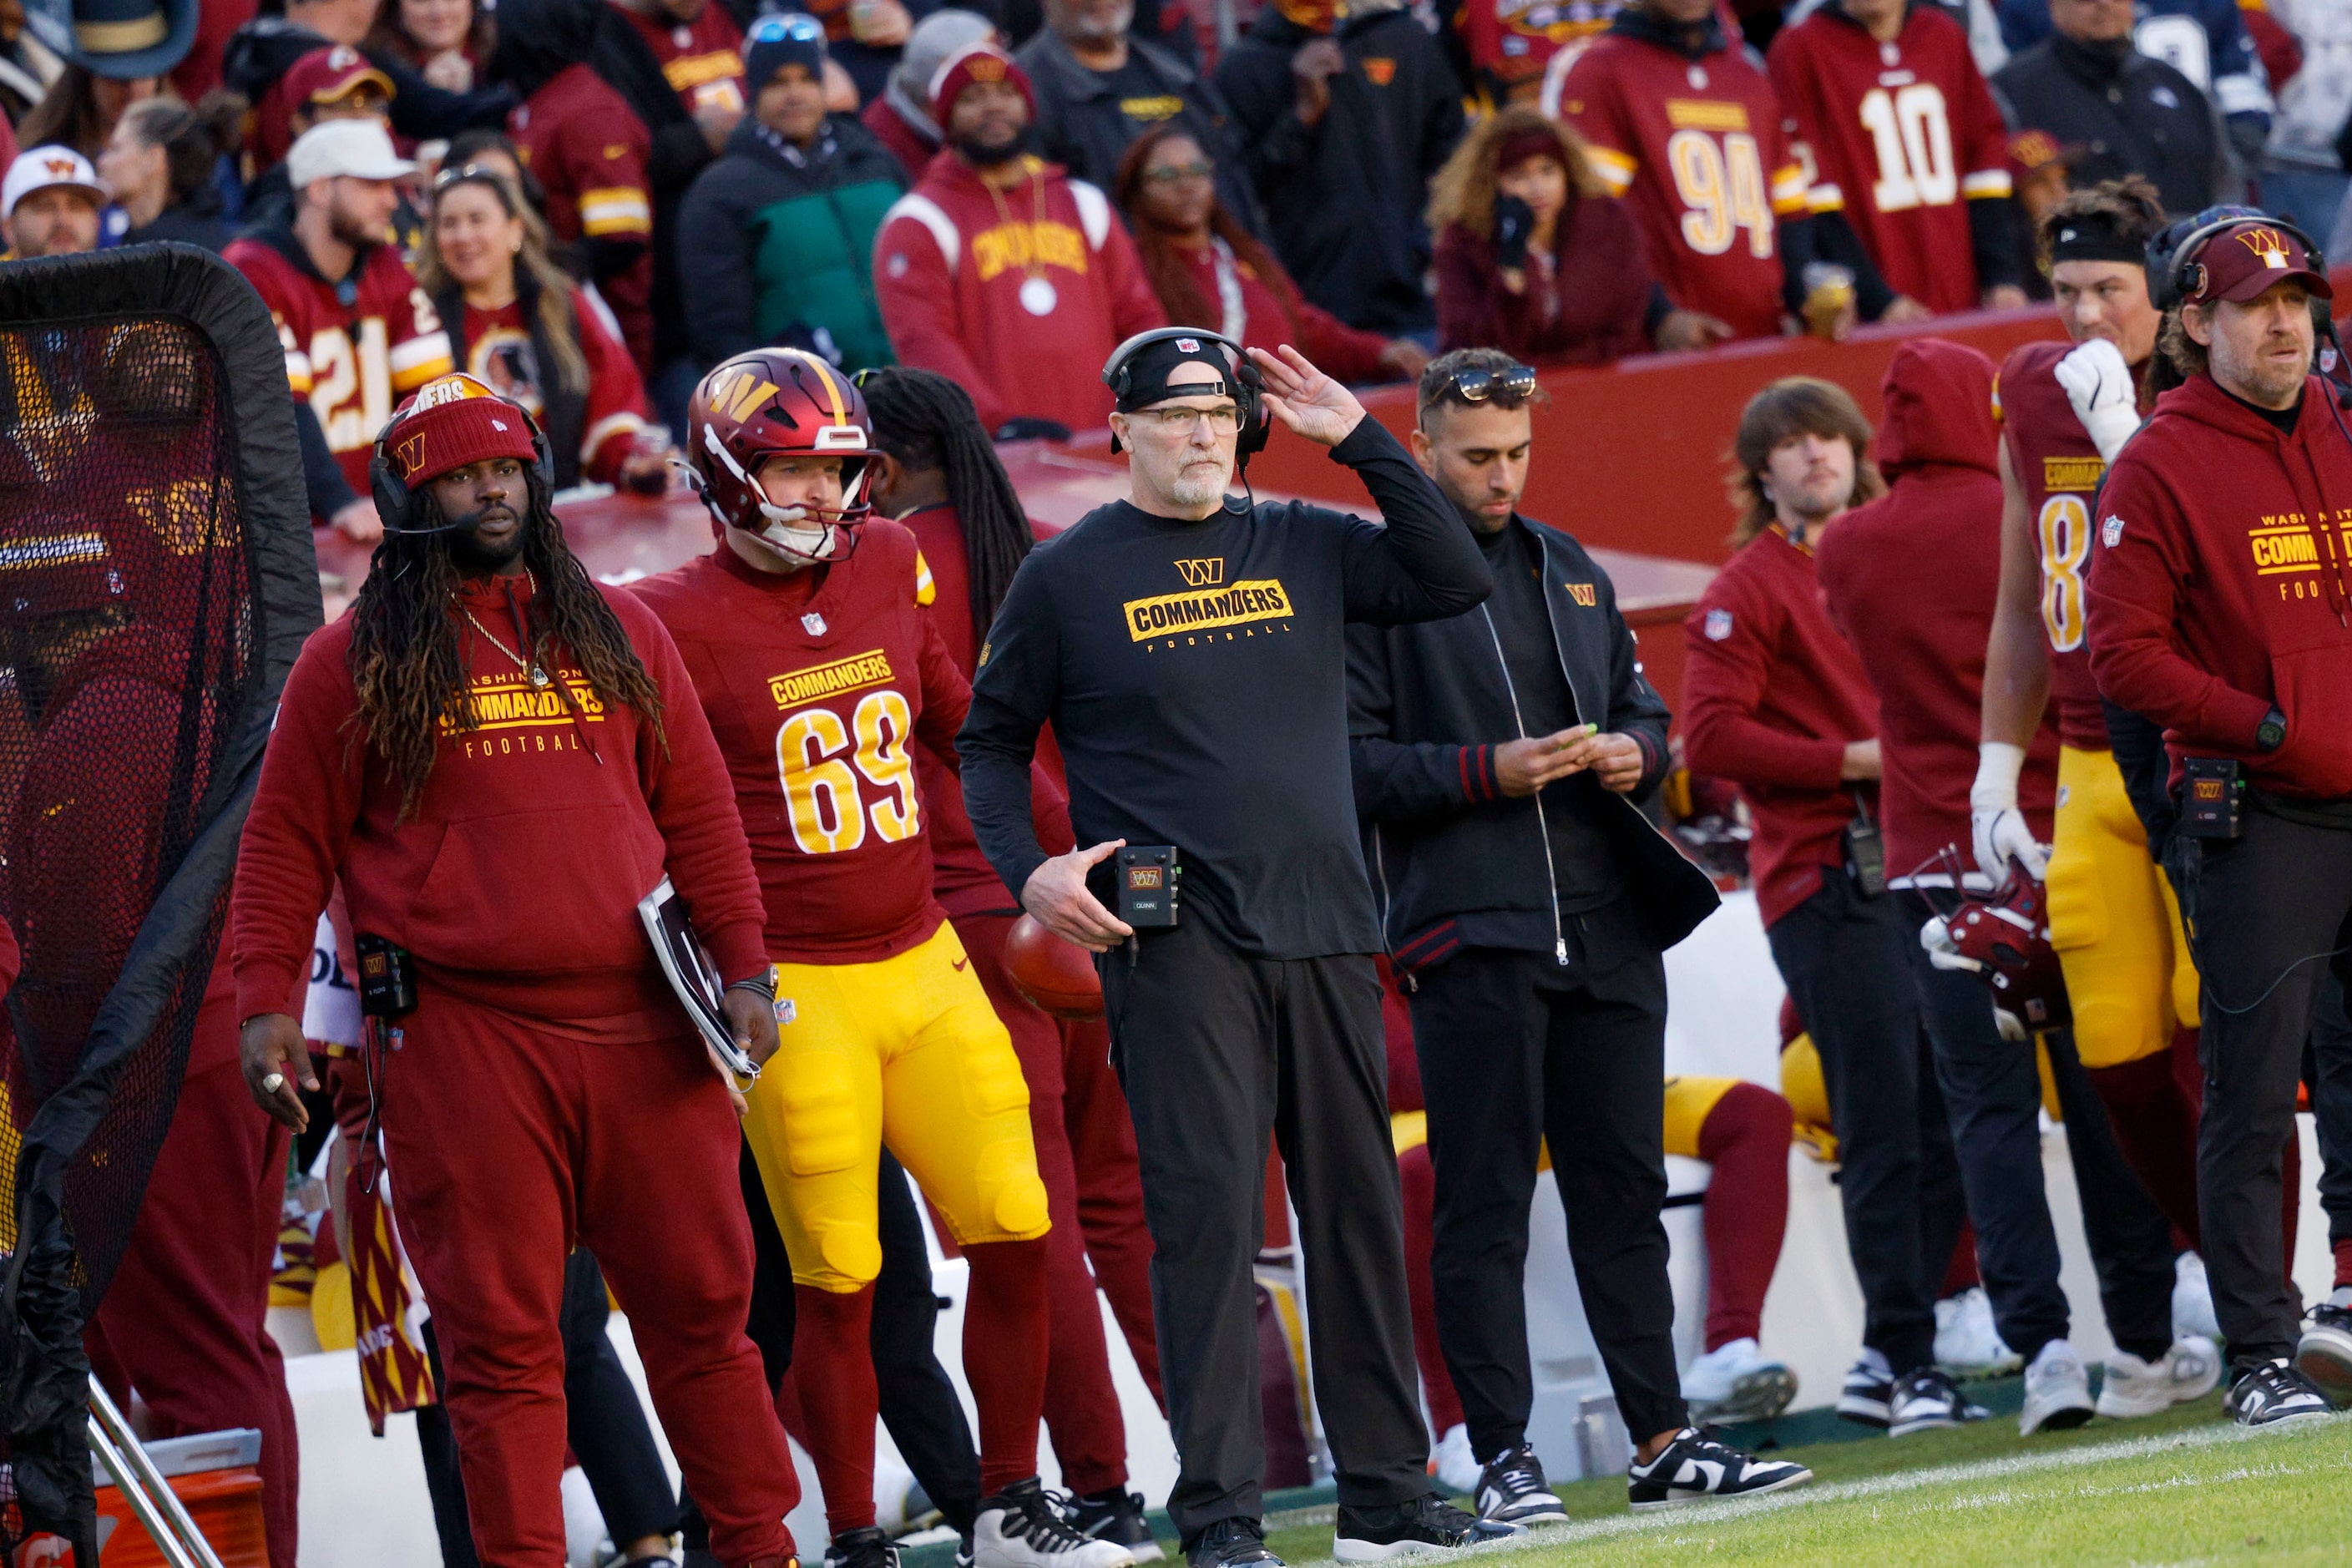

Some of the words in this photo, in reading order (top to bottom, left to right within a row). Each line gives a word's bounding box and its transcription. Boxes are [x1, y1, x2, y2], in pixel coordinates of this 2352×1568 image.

[1667, 129, 1774, 260] 94
[1859, 83, 1958, 214] 10
[309, 316, 393, 453] 21
[1133, 587, 1284, 632] COMMANDERS
[1147, 624, 1290, 653] FOOTBALL
[2038, 493, 2091, 654] 8
[771, 655, 893, 705] COMMANDERS
[465, 733, 579, 759] FOOTBAL
[776, 690, 920, 854] 69
